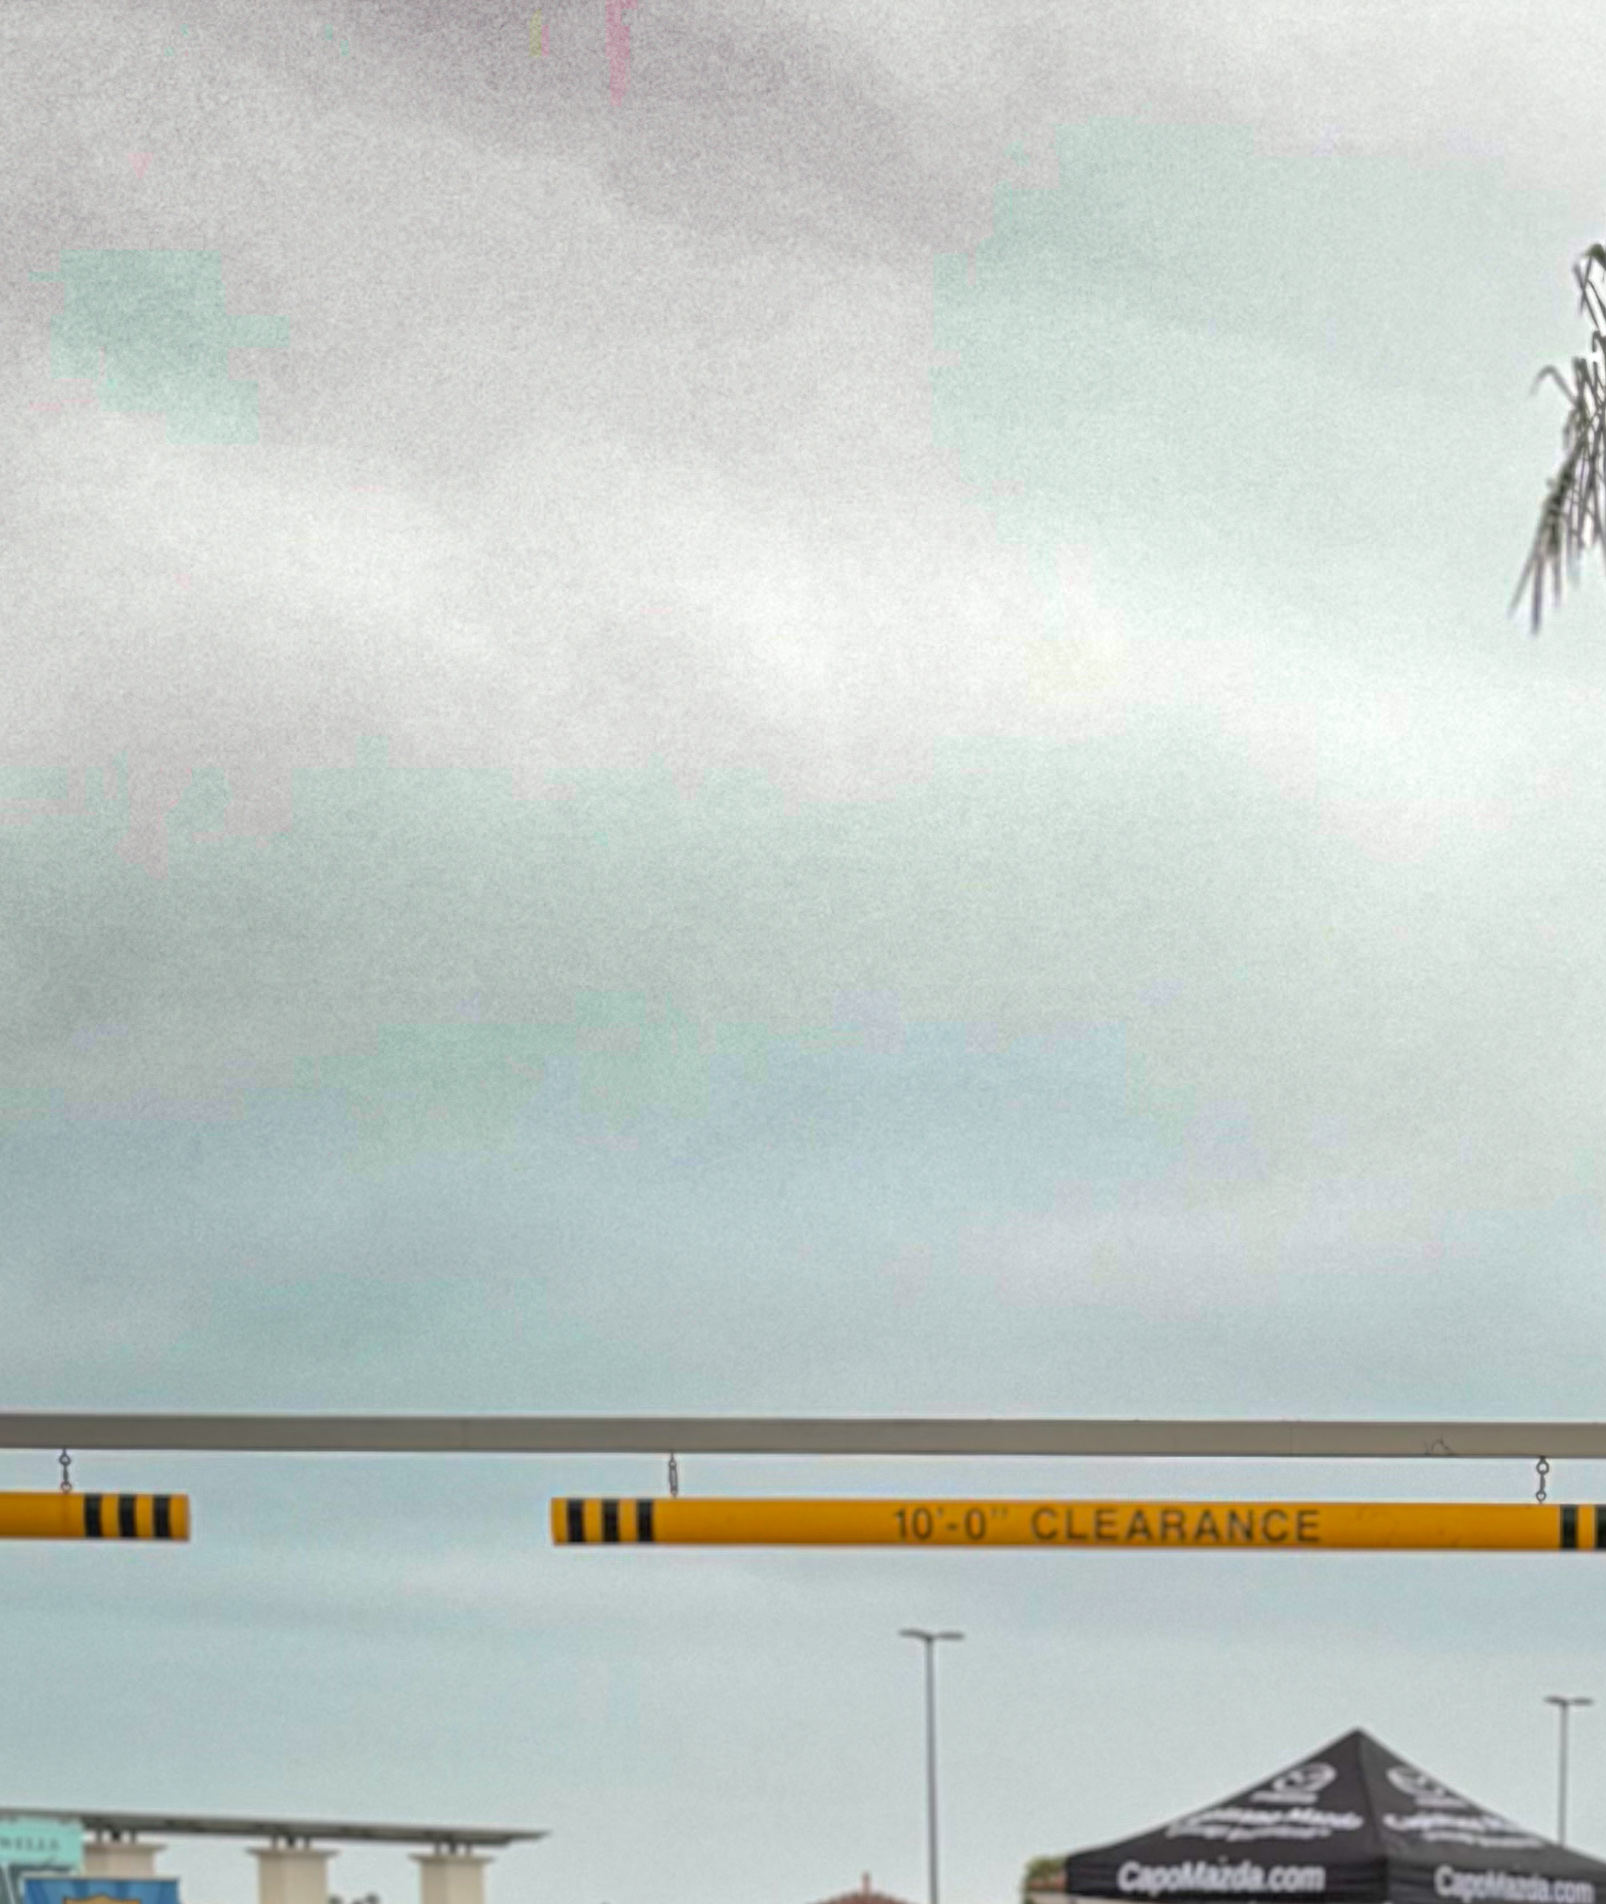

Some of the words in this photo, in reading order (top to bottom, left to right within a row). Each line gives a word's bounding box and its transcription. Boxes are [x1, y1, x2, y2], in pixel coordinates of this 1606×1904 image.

[1031, 1506, 1321, 1543] CLEARANCE
[1117, 1859, 1326, 1897] CapoMazda.com
[1433, 1864, 1596, 1904] CapoMazda.com
